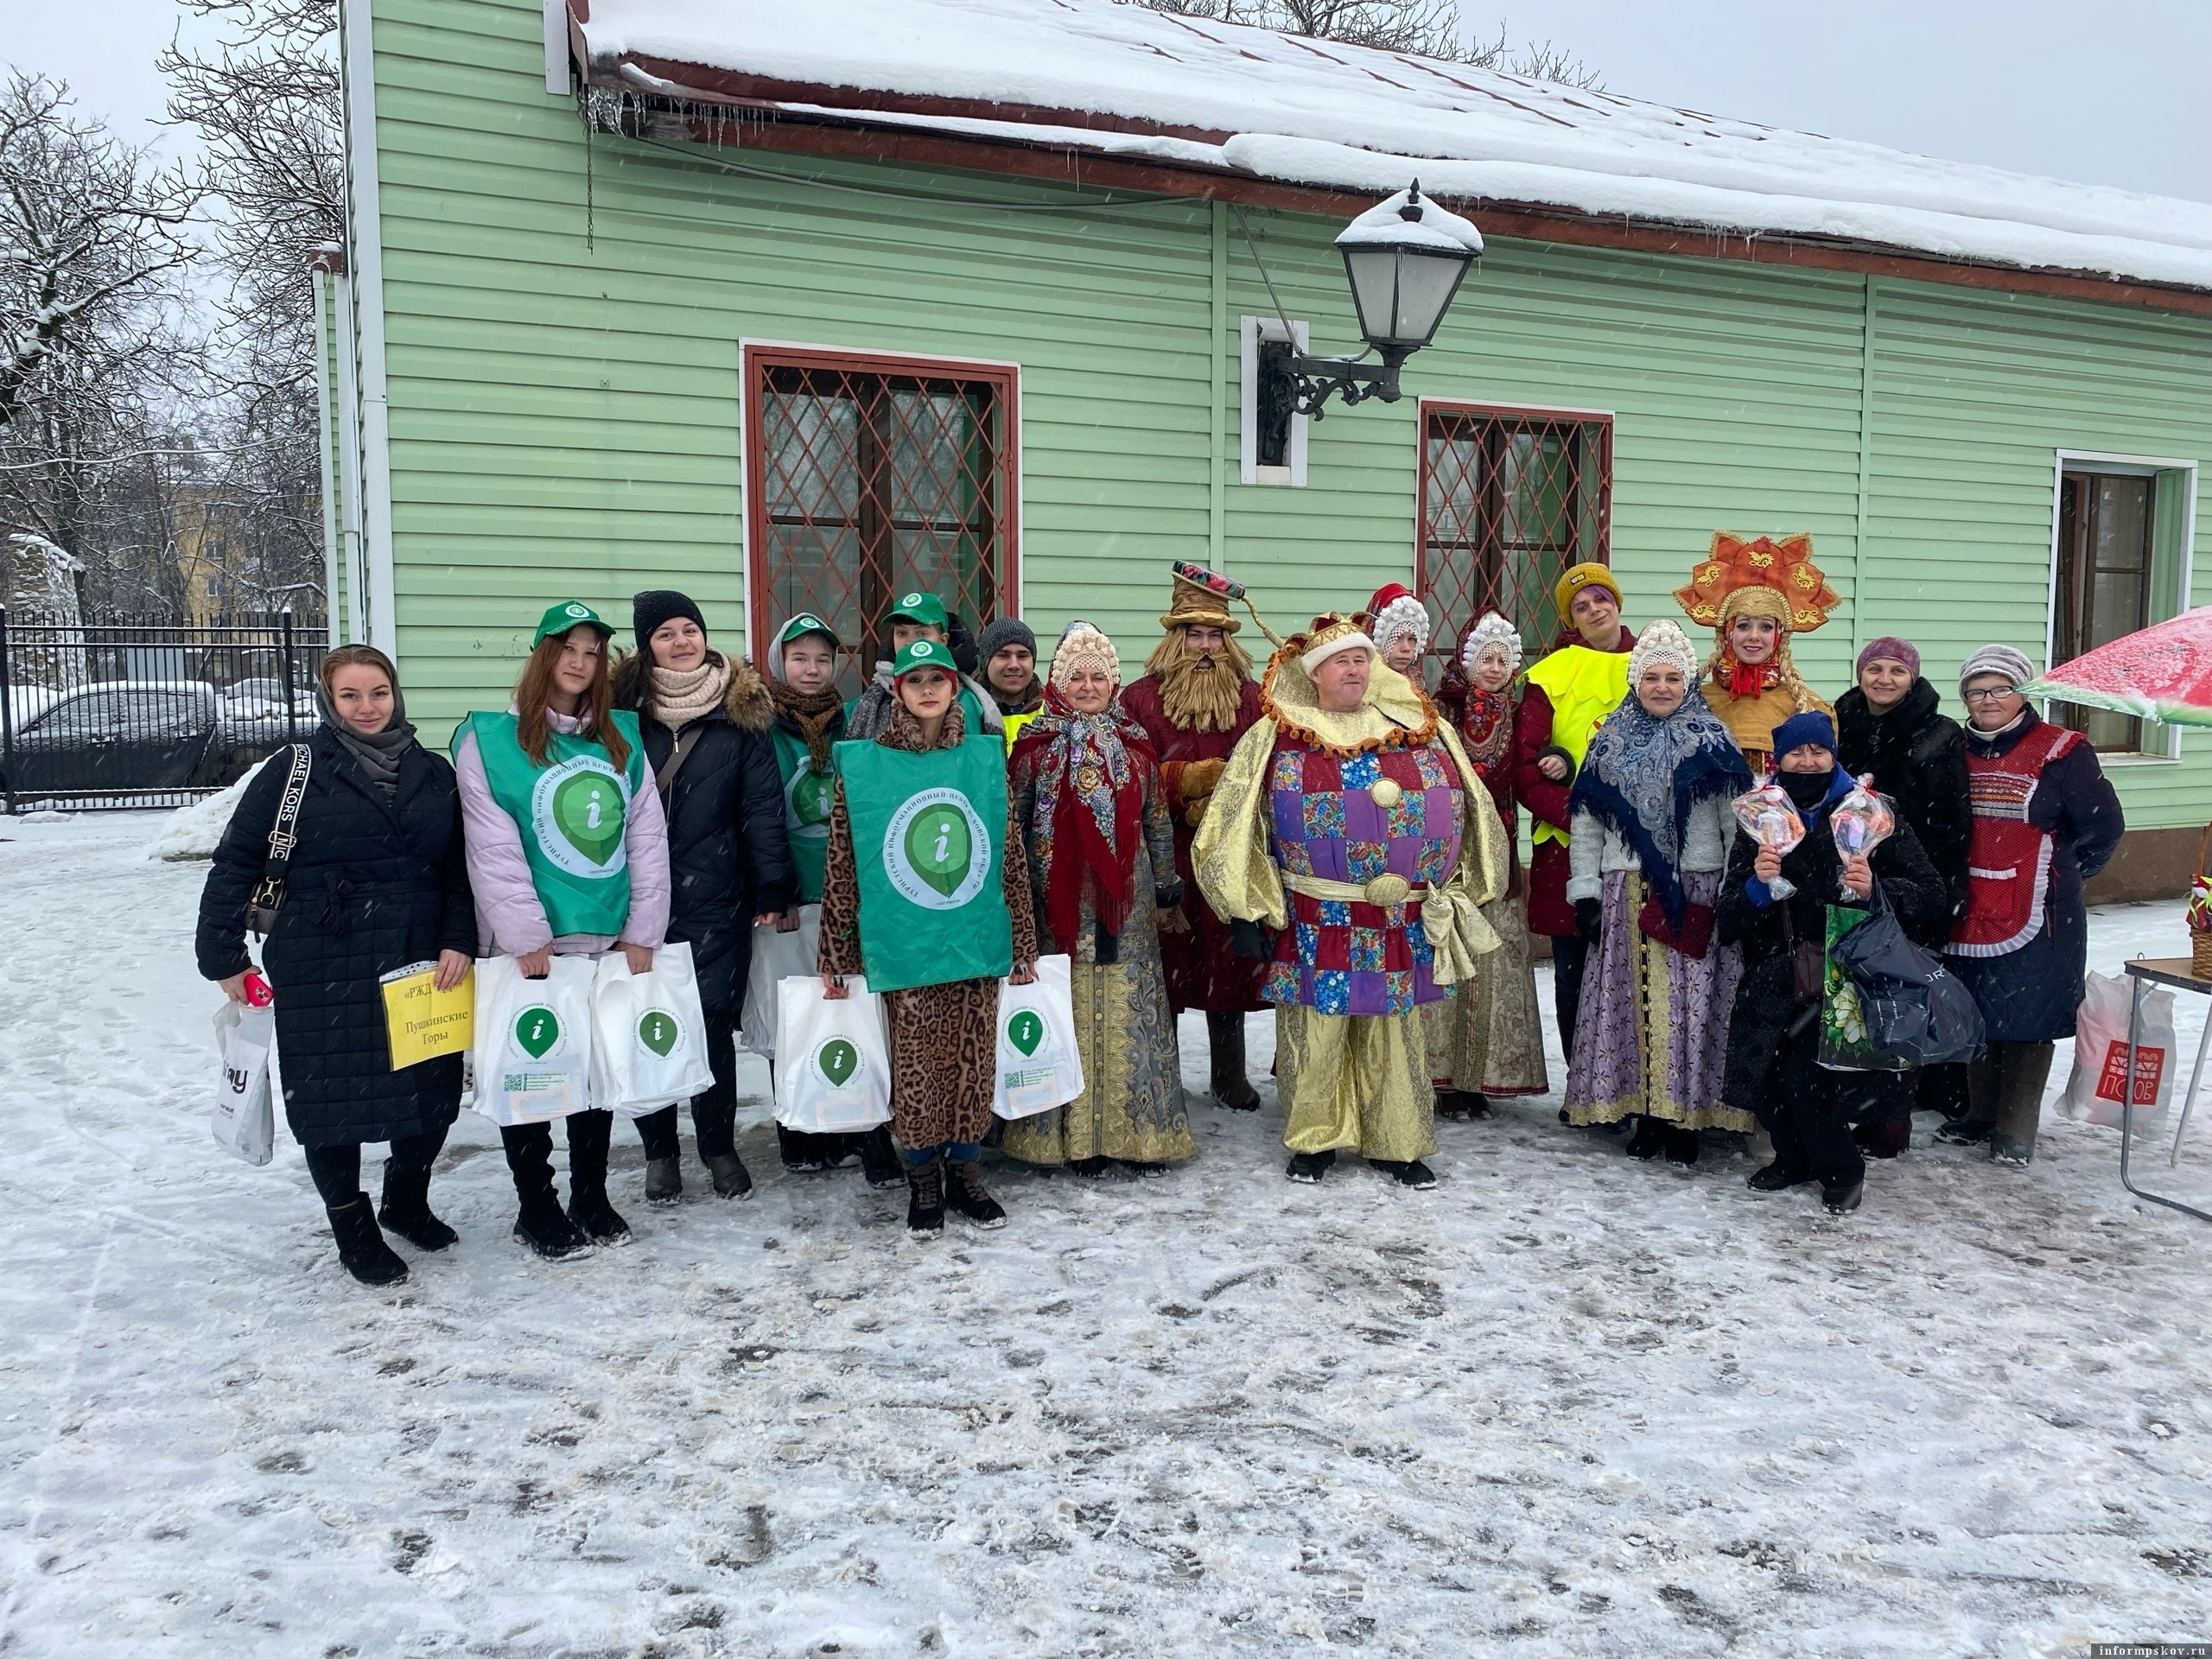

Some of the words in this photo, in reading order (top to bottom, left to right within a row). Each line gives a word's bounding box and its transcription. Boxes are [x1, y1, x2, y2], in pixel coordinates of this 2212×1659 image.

[281, 787, 301, 822] KORS
[536, 817, 570, 865] ТУРИСТСКИЙ
[592, 761, 615, 773] ЦЕНТ
[888, 791, 945, 848] ИНФОРМАЦИОННЫЙ
[968, 810, 988, 855] ПСКОВСКОЙ
[887, 852, 918, 898] ТУРИСТСКИЙ
[404, 983, 431, 999] «РЖД
[406, 1012, 468, 1034] Пушкинские
[423, 1032, 448, 1045] Горы
[2102, 1075, 2153, 1100] ПСОВ
